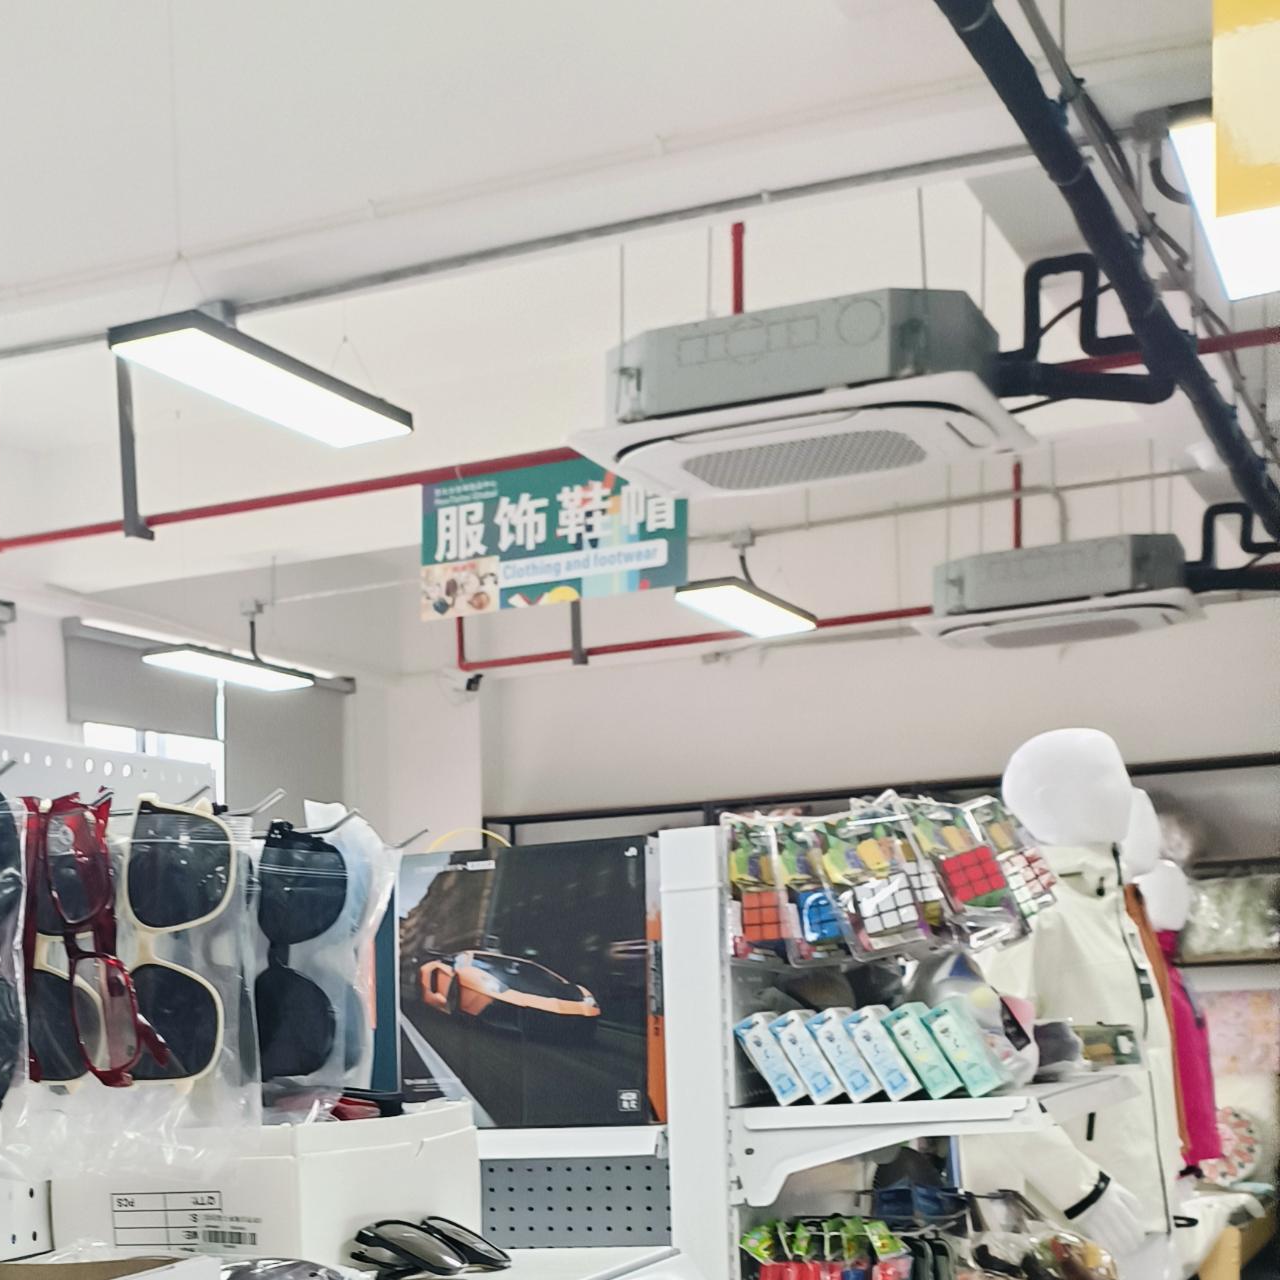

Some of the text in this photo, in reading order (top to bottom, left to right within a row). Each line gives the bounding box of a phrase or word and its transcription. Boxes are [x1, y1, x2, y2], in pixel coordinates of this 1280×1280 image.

[434, 481, 675, 562] 服饰鞋帽
[503, 546, 659, 581] Clothing and footwear
